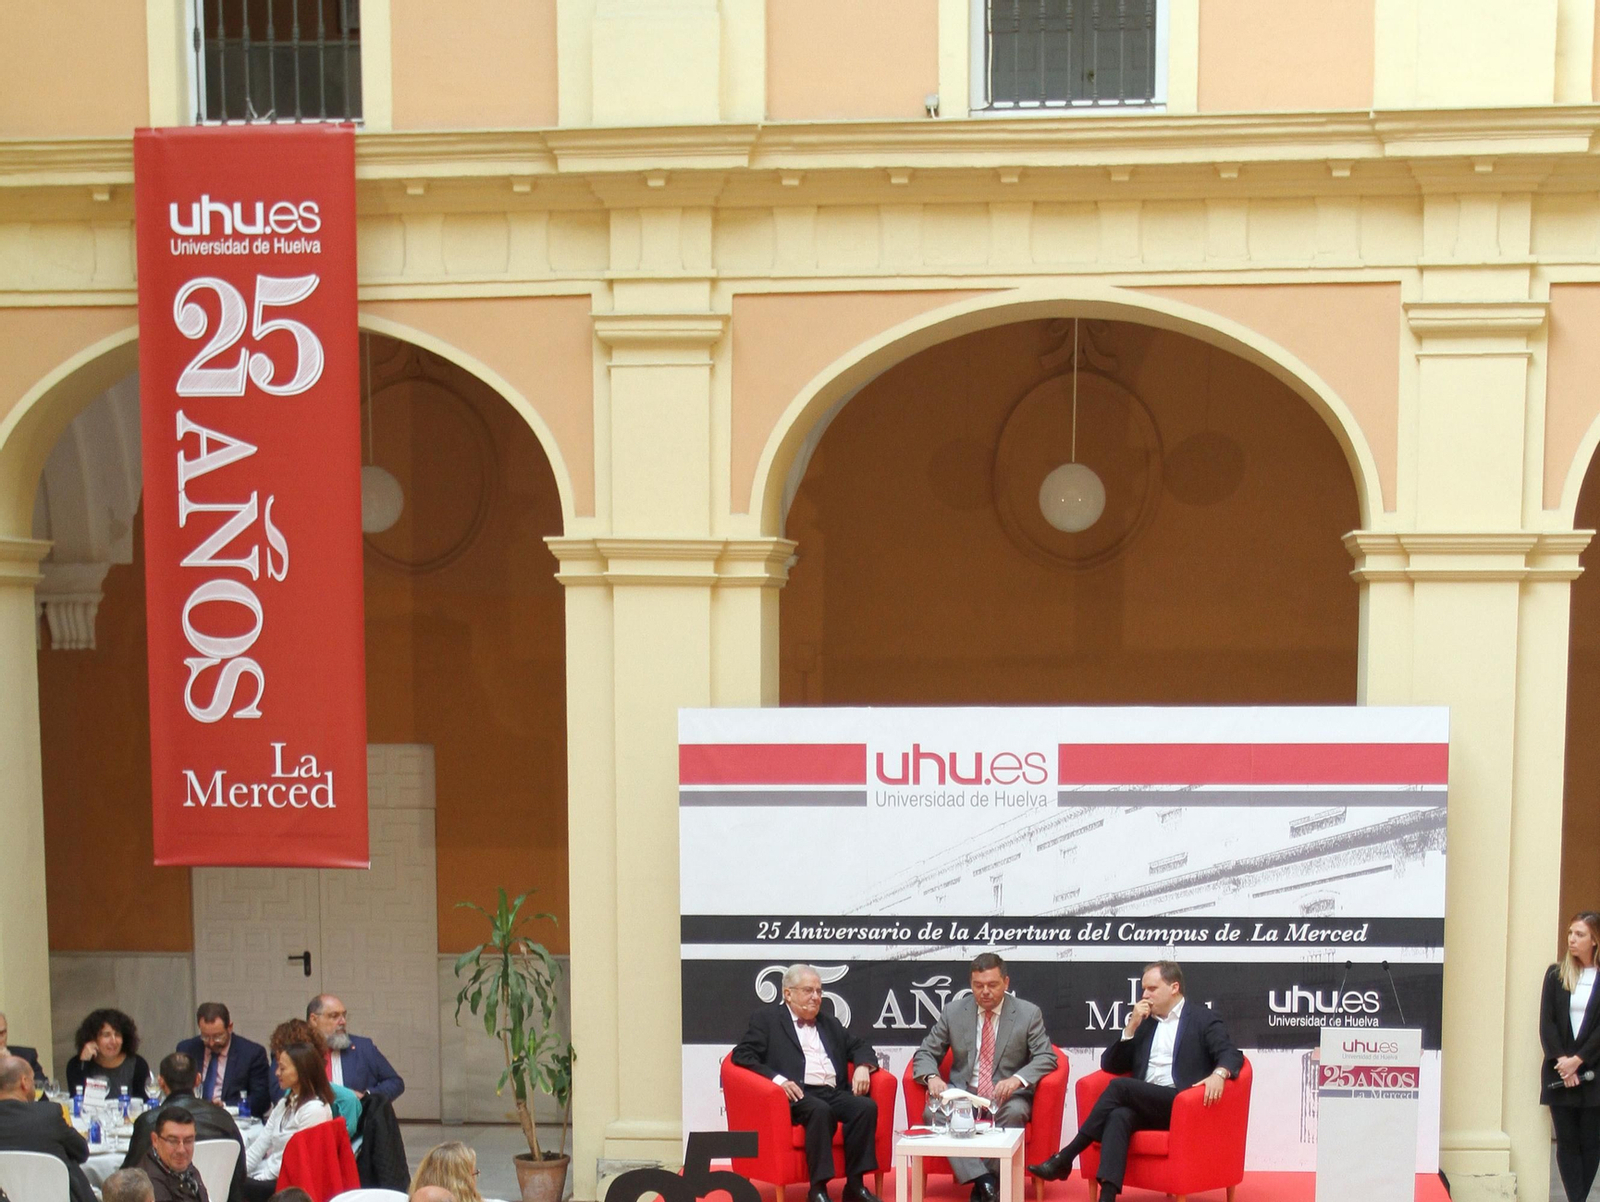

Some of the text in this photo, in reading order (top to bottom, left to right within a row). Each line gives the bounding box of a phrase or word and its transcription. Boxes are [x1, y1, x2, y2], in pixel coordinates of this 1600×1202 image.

[169, 194, 321, 235] uhu.es
[170, 237, 321, 256] Universidad de Huelva
[173, 274, 324, 396] 25
[176, 409, 289, 723] AÑOS
[270, 743, 321, 778] La
[876, 743, 1049, 786] uhu.es
[182, 771, 336, 808] Merced
[875, 790, 1047, 807] Universidad de Huelva
[756, 920, 1368, 946] 25 Aniversario de la Apertura del Campus de La Merced
[1268, 985, 1380, 1013] uhu.es
[1268, 1015, 1326, 1027] Universidad
[1344, 1015, 1379, 1027] Huelva
[1342, 1039, 1399, 1053] uhu.es
[1323, 1065, 1415, 1088] 25 AÑOS
